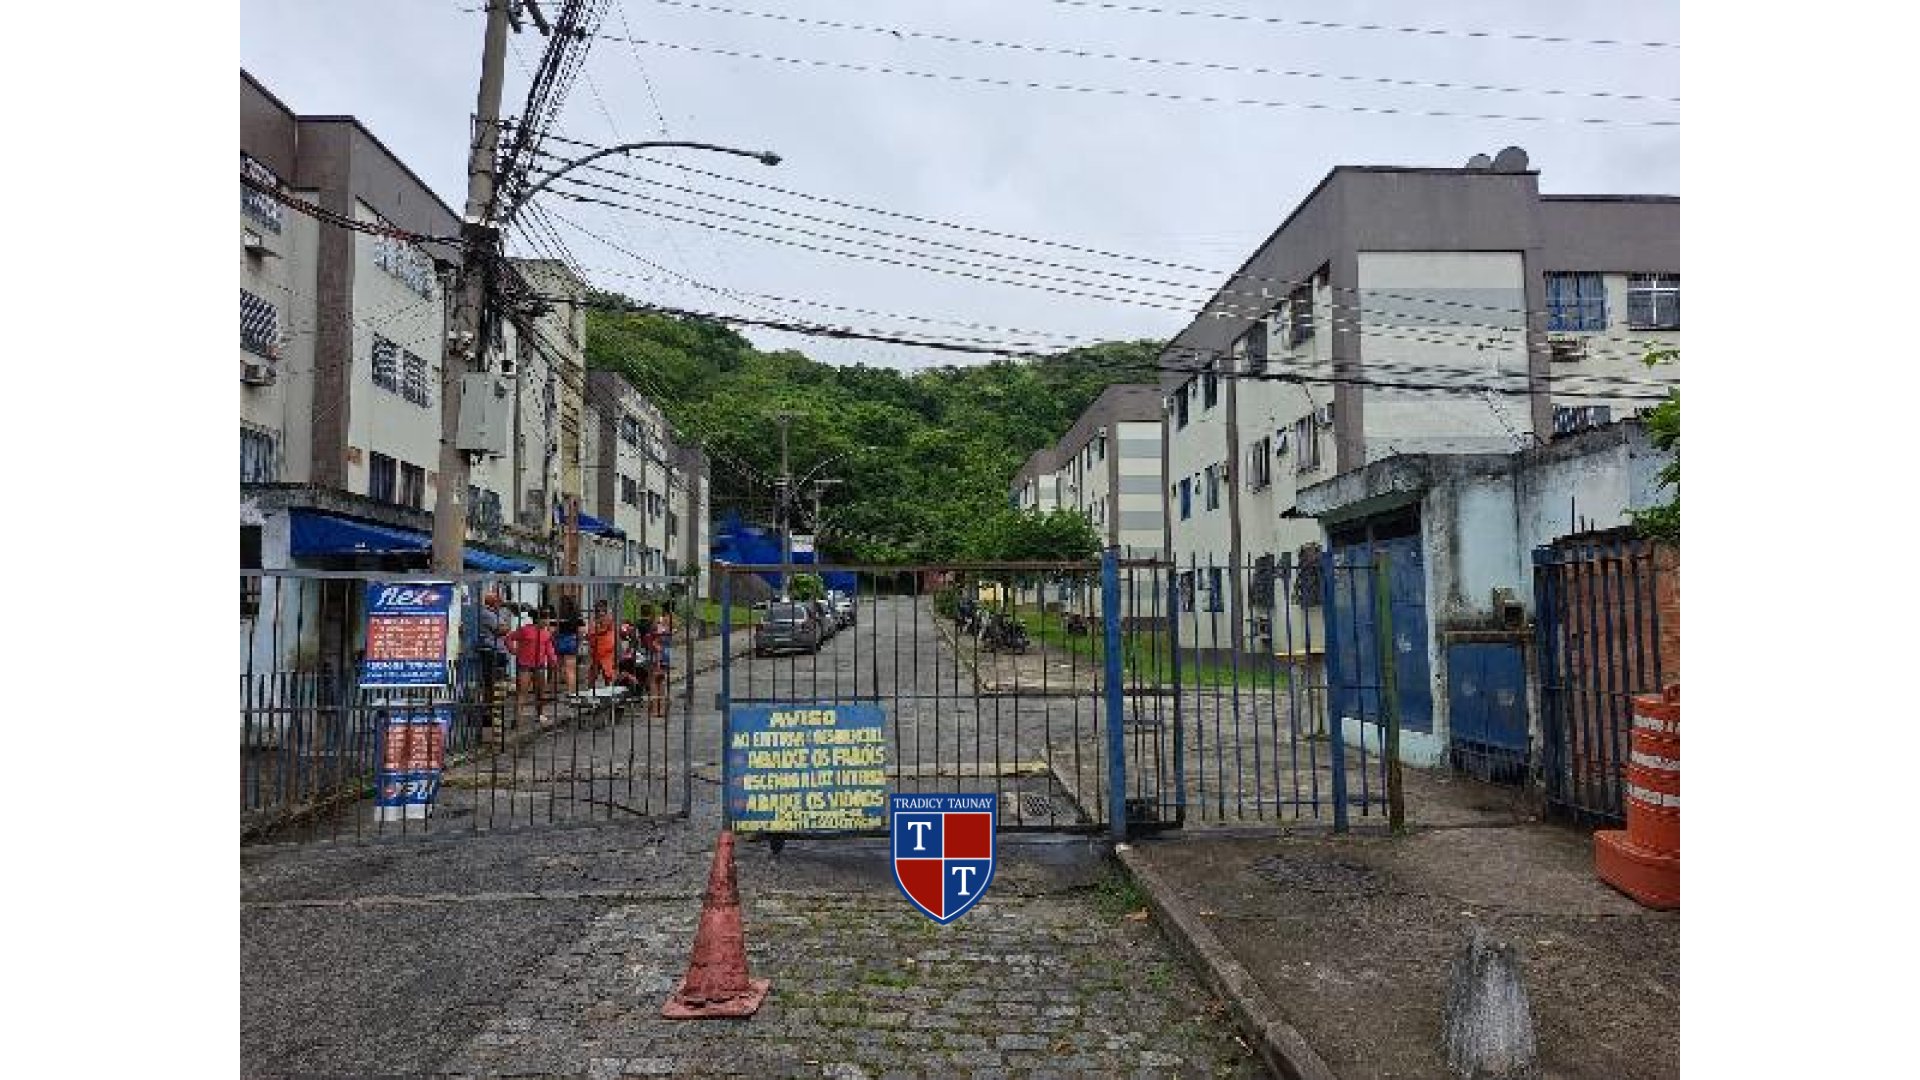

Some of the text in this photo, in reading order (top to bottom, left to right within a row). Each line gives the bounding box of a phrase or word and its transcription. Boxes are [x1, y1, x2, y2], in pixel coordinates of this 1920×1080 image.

[770, 710, 836, 727] AVISO
[748, 749, 809, 768] ABAIXE
[812, 748, 831, 768] OS
[806, 791, 826, 809] OS
